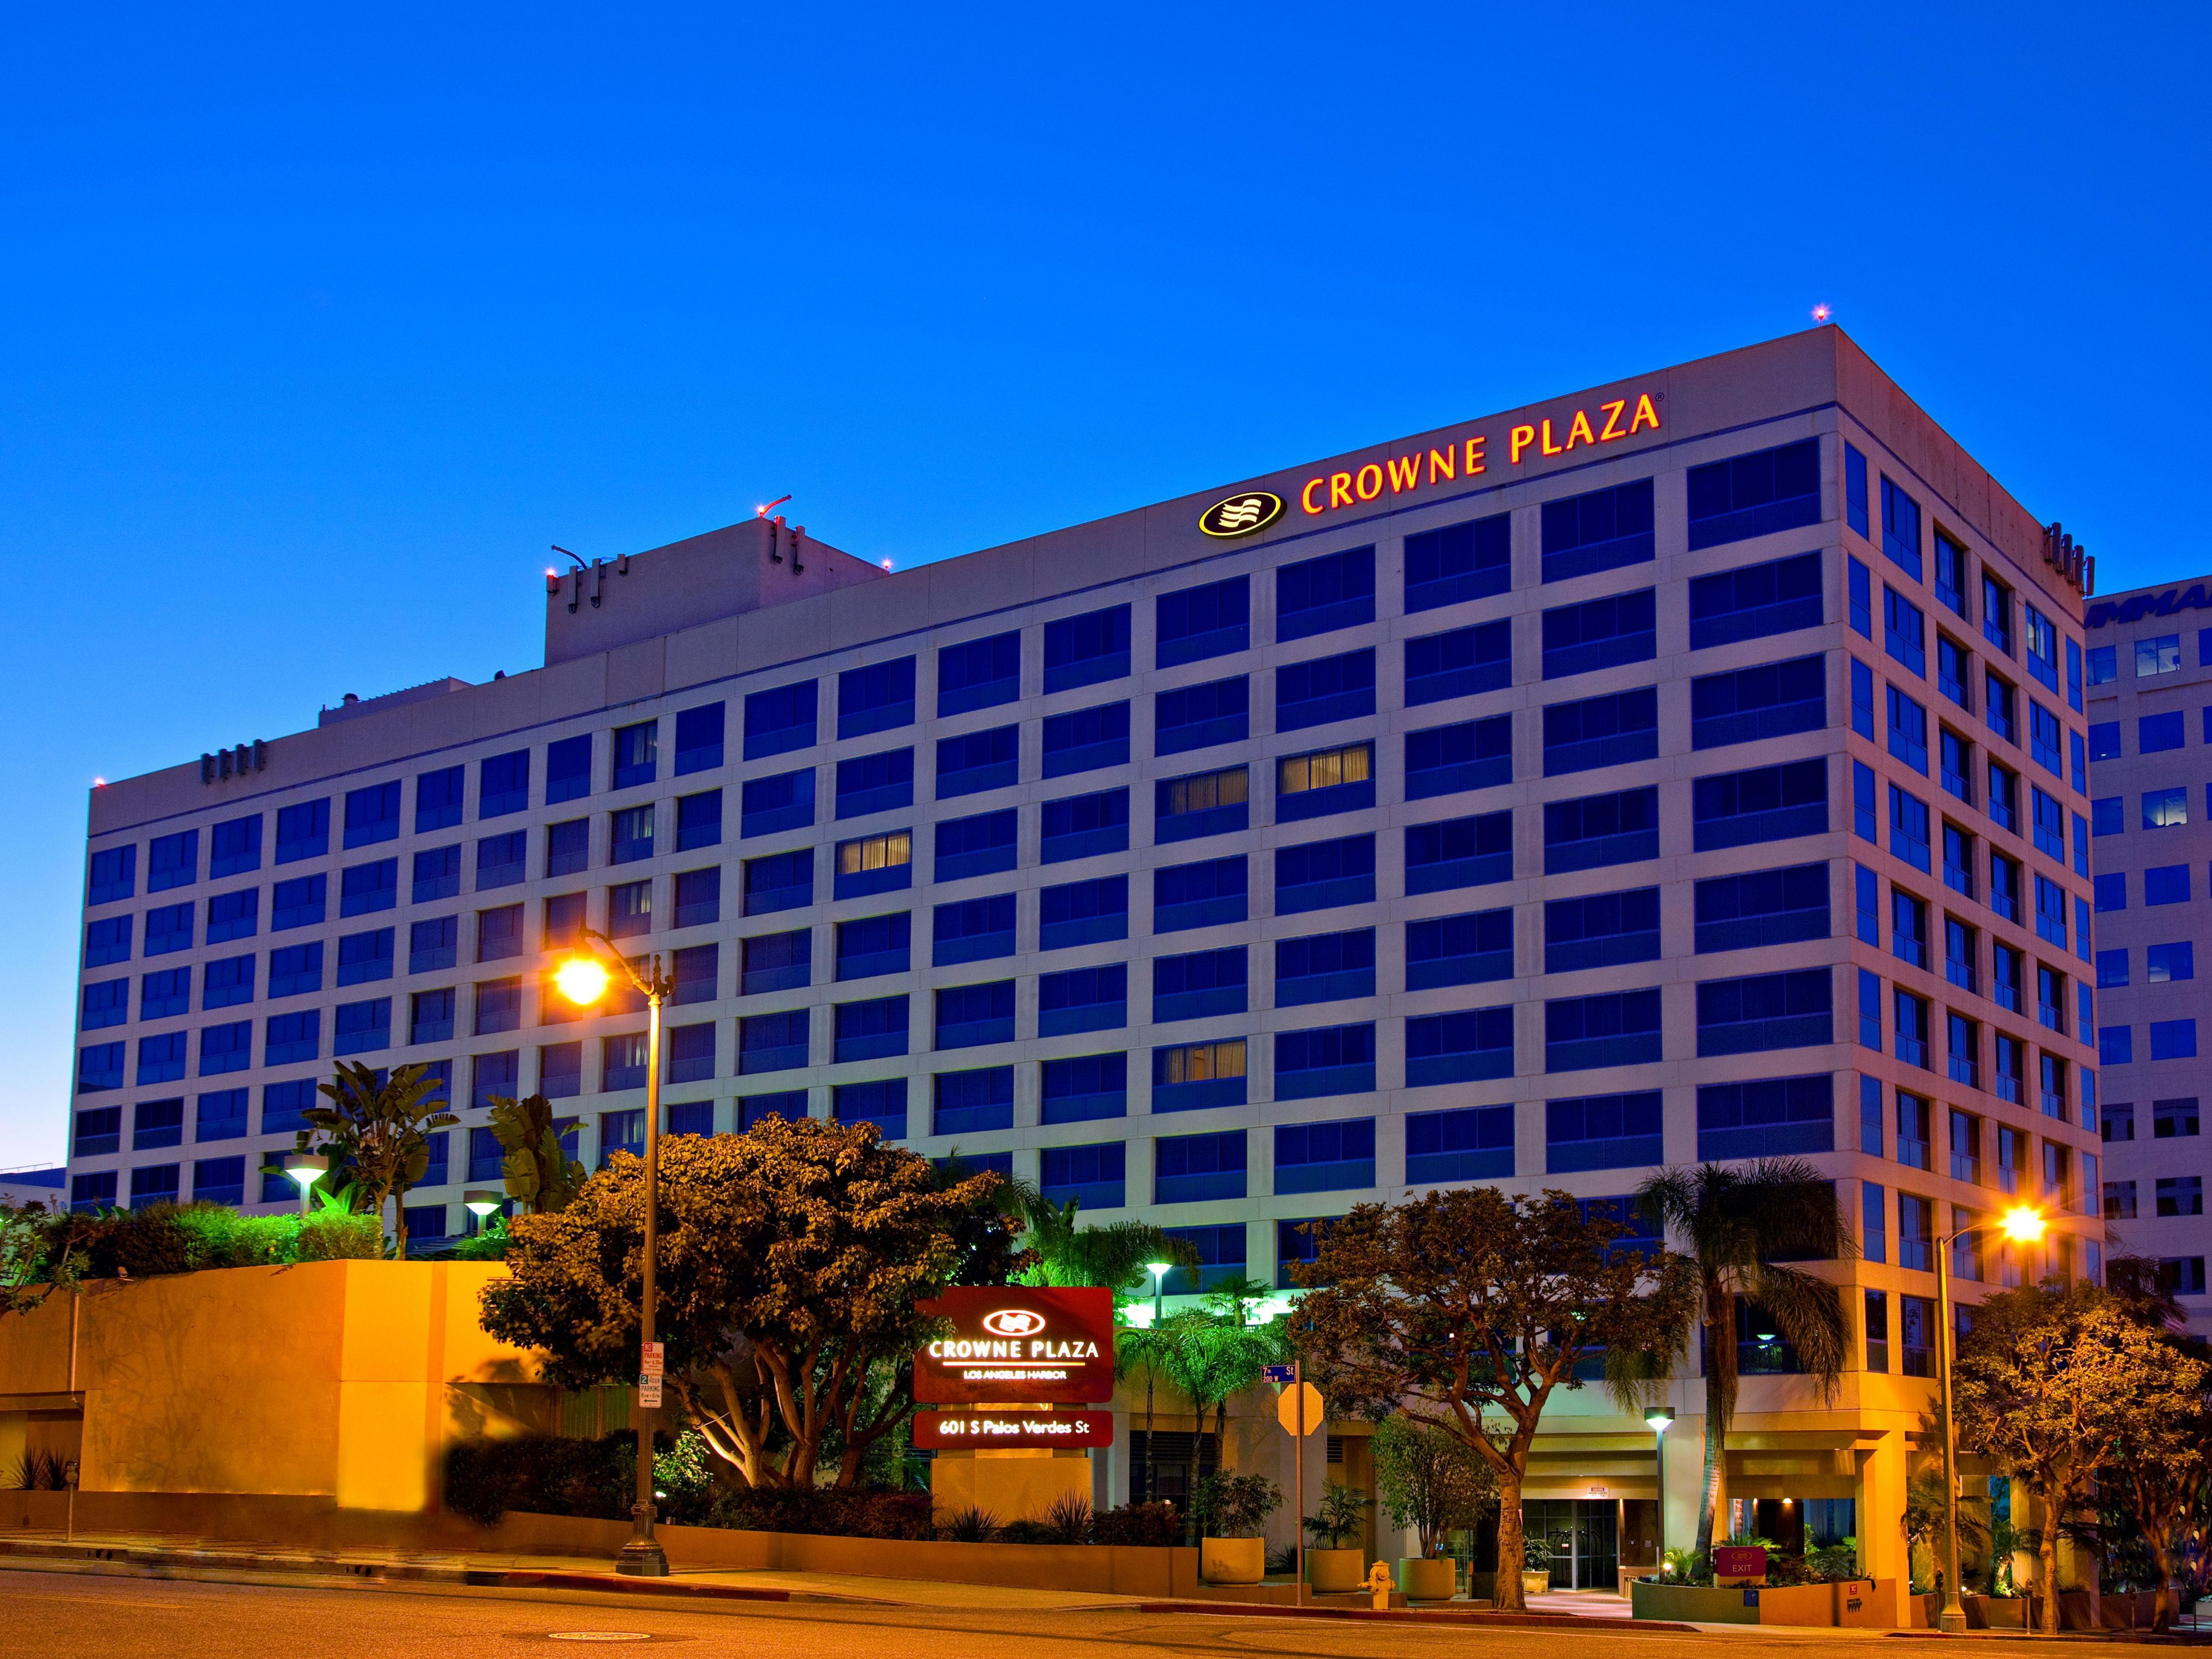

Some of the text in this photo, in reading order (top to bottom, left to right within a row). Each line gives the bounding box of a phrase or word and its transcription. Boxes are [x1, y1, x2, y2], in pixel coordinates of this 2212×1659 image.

[1302, 393, 1660, 515] CROWNE PLAZA
[928, 1340, 1099, 1358] CROWNE PLAZA
[963, 1370, 1067, 1380] LOS ANGELES HARBOR
[1262, 1366, 1294, 1376] 7th St
[641, 1375, 647, 1384] 2
[940, 1420, 1090, 1434] 601 S Palos Verdes St
